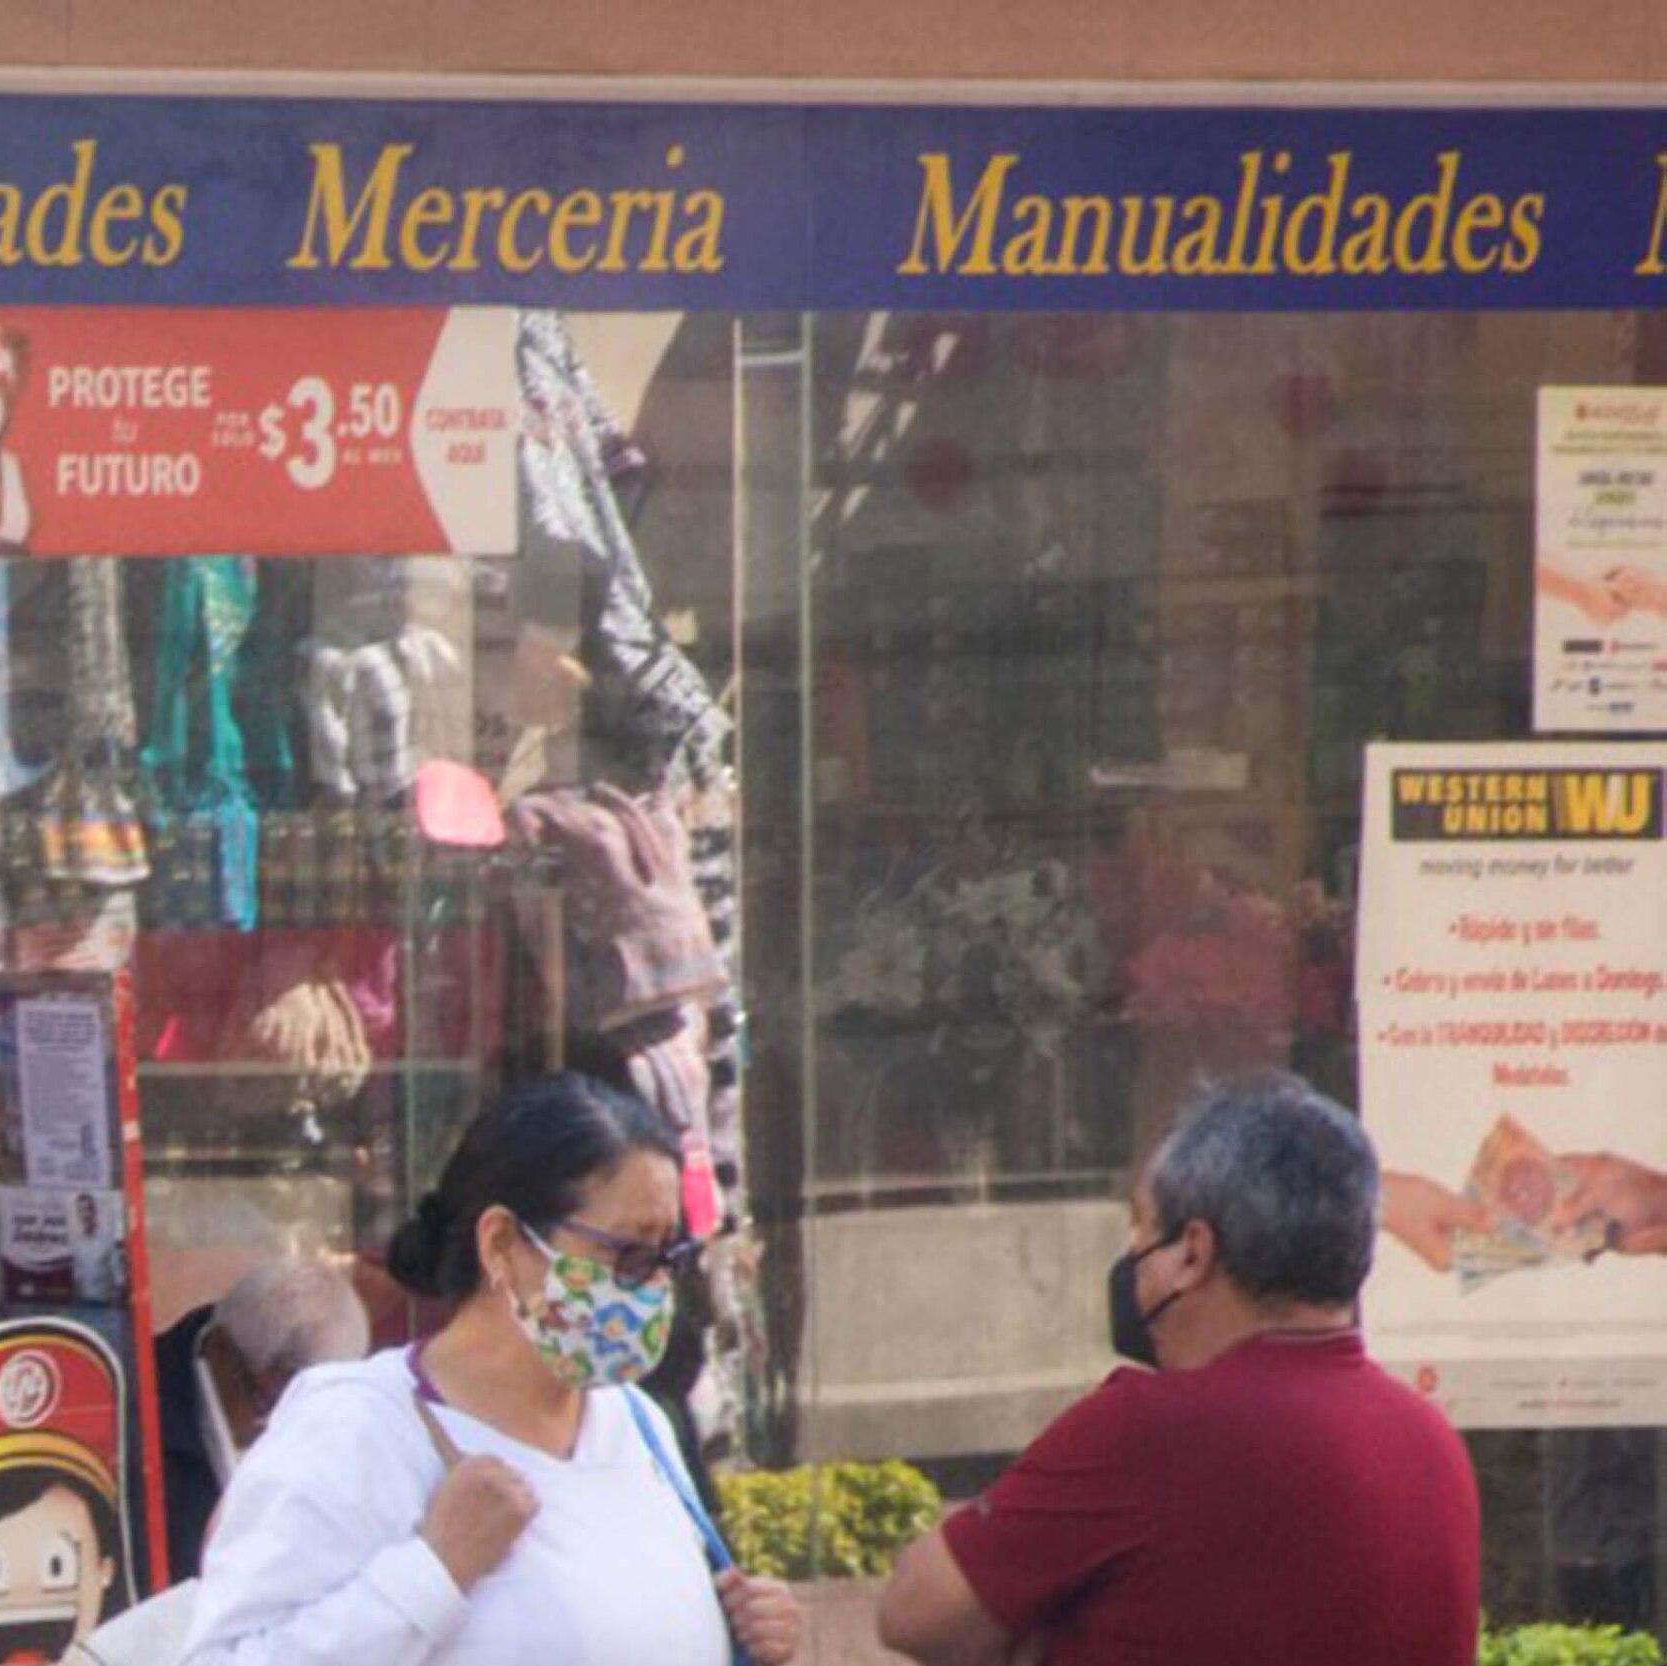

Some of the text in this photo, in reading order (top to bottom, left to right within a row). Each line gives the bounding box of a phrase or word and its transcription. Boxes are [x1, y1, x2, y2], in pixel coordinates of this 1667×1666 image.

[897, 150, 1546, 276] Manualidades
[47, 365, 213, 407] PROTEGE
[56, 453, 202, 497] FUTURO
[1397, 773, 1548, 804] WESTERN
[1442, 803, 1548, 834] UNION
[1419, 854, 1635, 879] moving money for better
